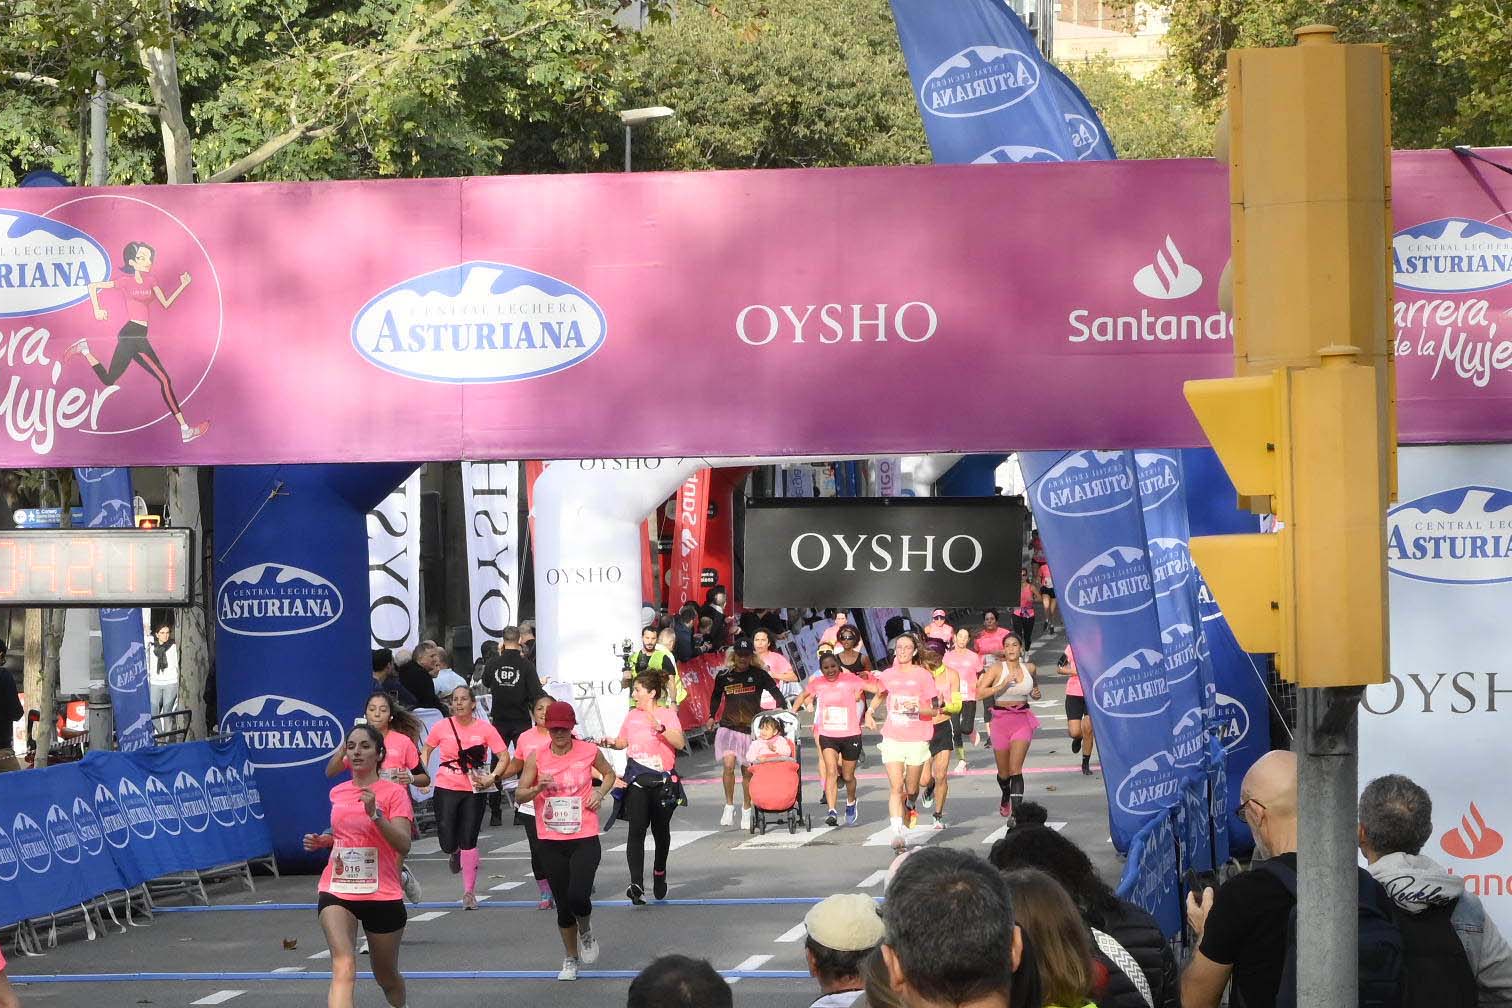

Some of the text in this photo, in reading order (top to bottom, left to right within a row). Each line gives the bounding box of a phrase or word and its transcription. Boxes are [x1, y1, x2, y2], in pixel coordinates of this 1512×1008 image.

[14, 245, 87, 256] LECHERA
[1408, 243, 1458, 252] CENTRAL
[497, 302, 579, 315] LECHERA
[1394, 299, 1489, 327] arrera
[372, 309, 586, 353] ASTURIANA
[735, 301, 938, 346] OYSHO
[1068, 308, 1235, 342] Santand
[1418, 329, 1435, 356] la
[1431, 322, 1512, 388] Muje
[1415, 520, 1483, 531] CENTRAL
[791, 532, 983, 573] OYSHO
[546, 565, 622, 586] OYSHO
[234, 588, 329, 596] CENTRAL LECHERA
[221, 592, 334, 620] ASTURIANA
[1362, 672, 1512, 715] OYSH
[282, 719, 330, 728] LECHERA
[243, 730, 335, 750] TURIANA
